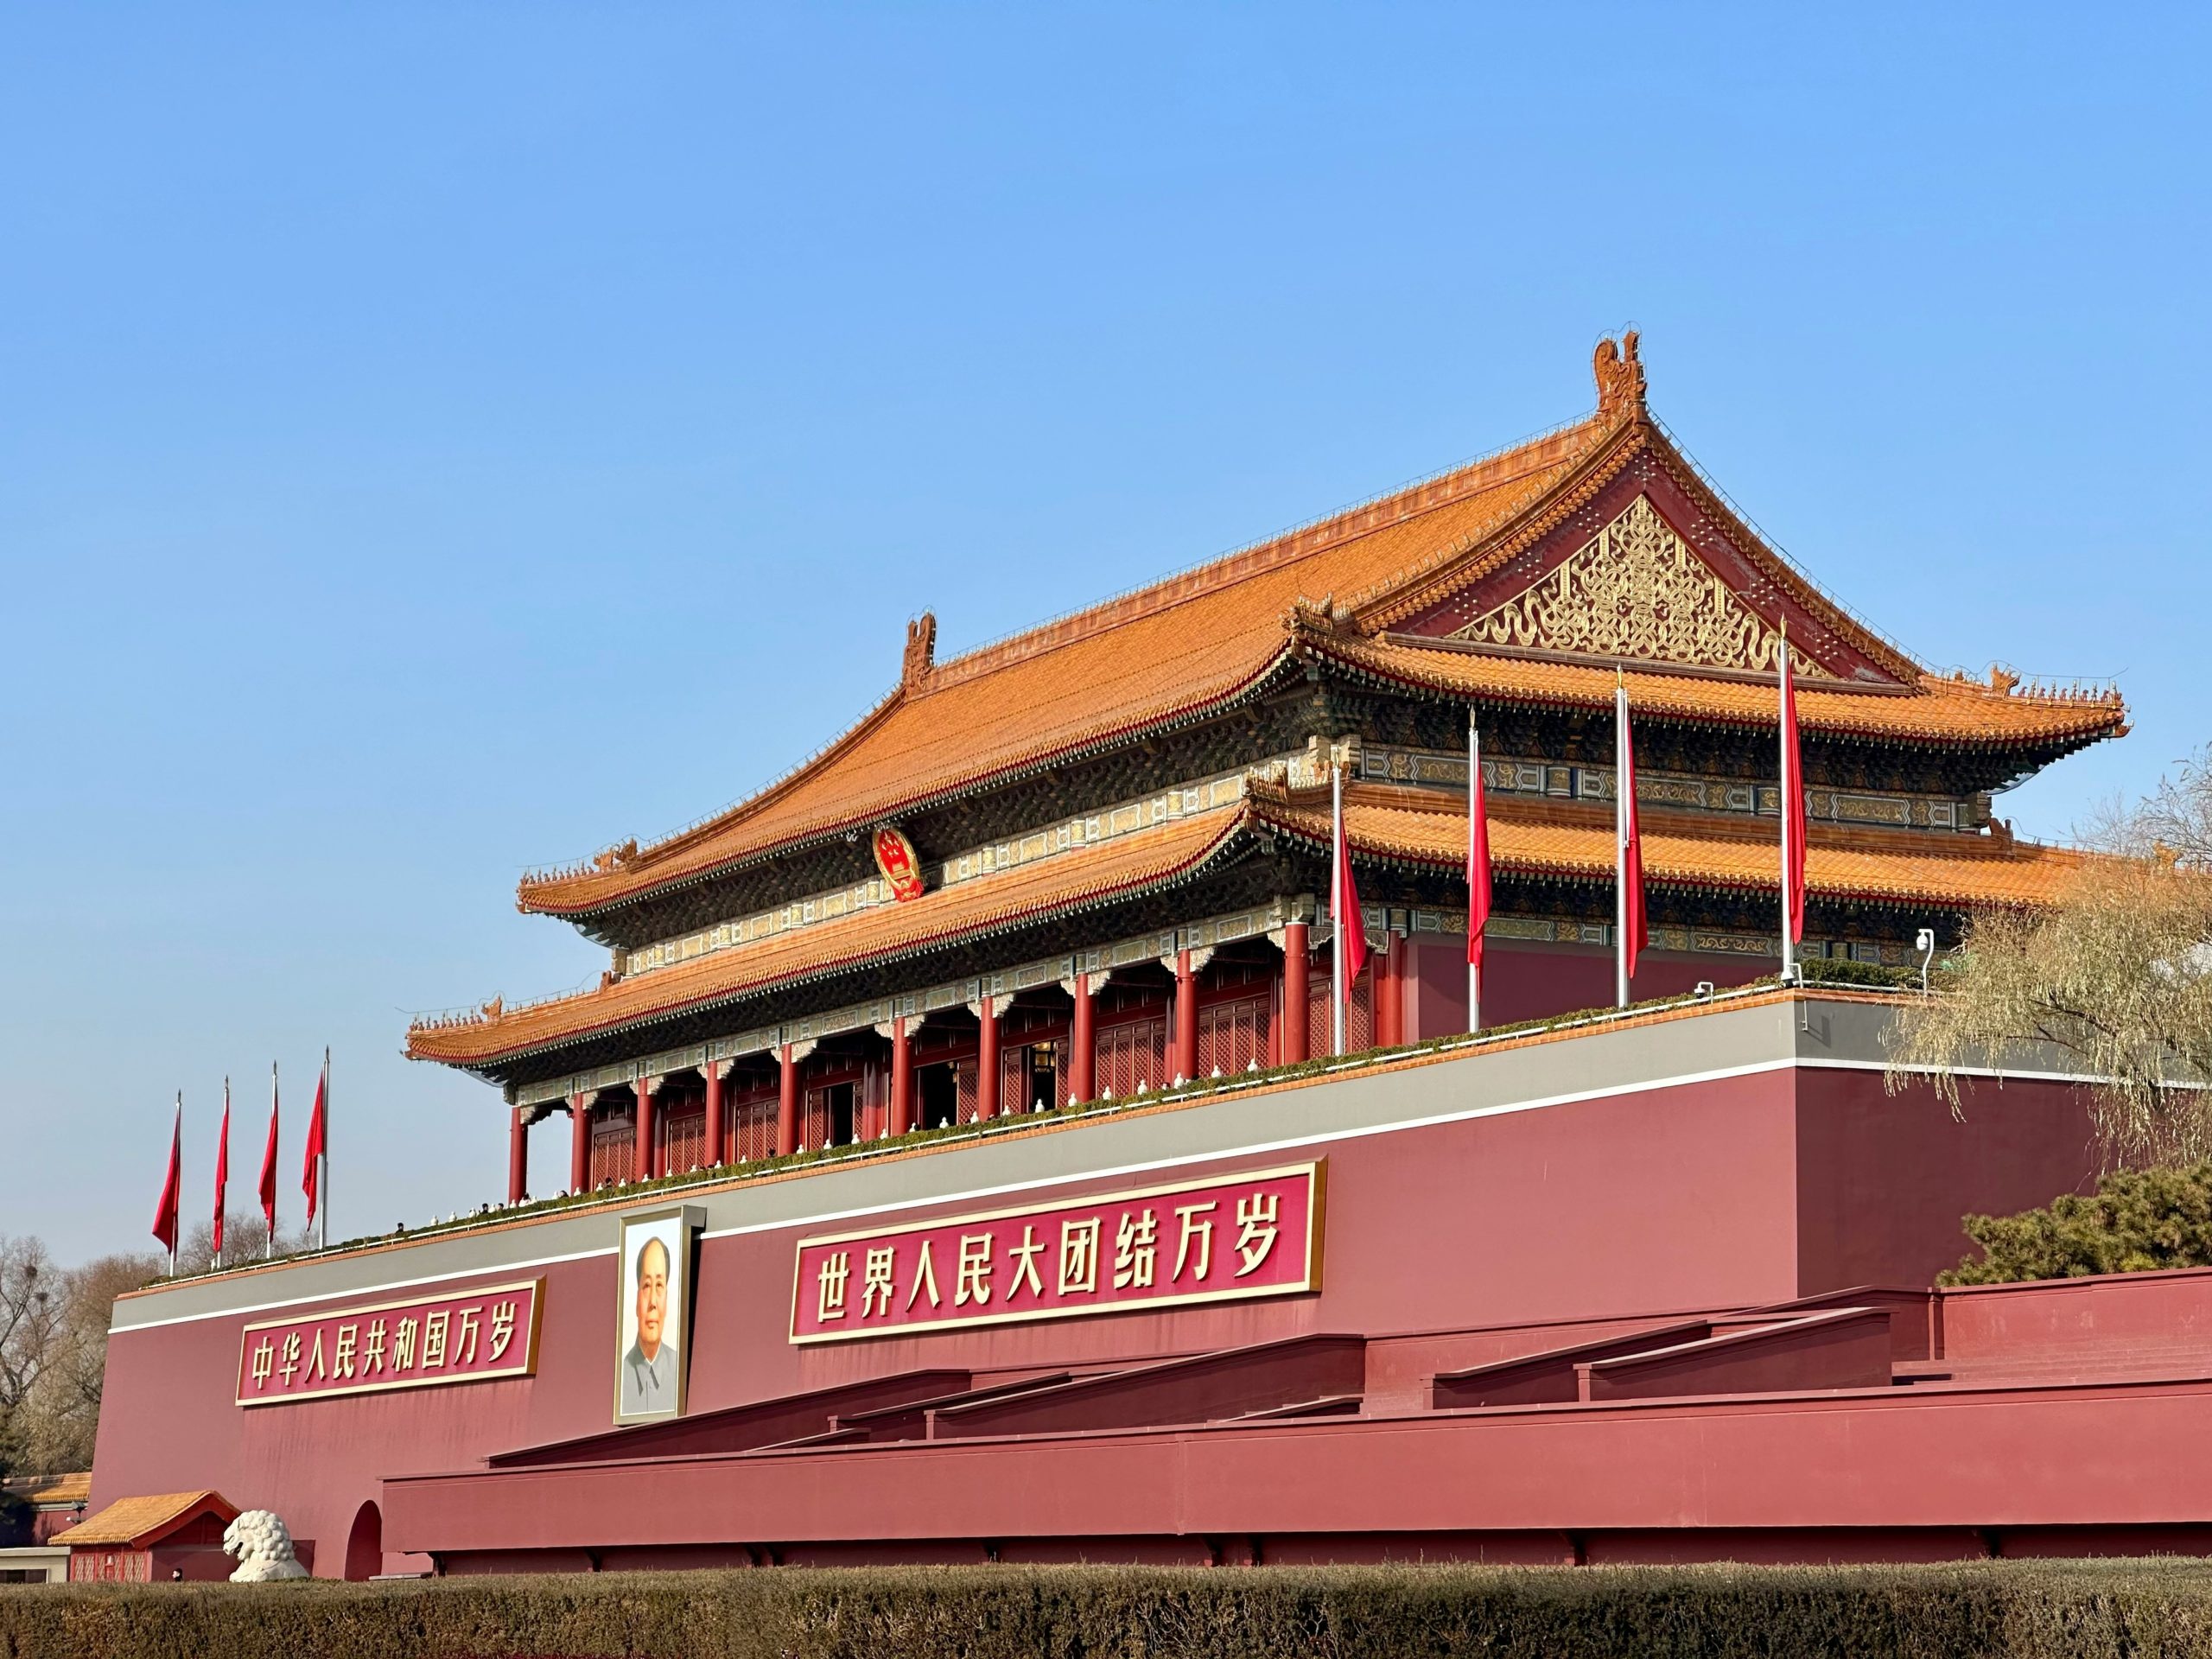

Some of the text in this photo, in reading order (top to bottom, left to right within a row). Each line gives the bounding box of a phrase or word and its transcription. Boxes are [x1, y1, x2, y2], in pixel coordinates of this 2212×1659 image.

[817, 1192, 1281, 1323] 世界人民大团结万岁
[251, 1300, 517, 1389] 中华人民共和国万岁
